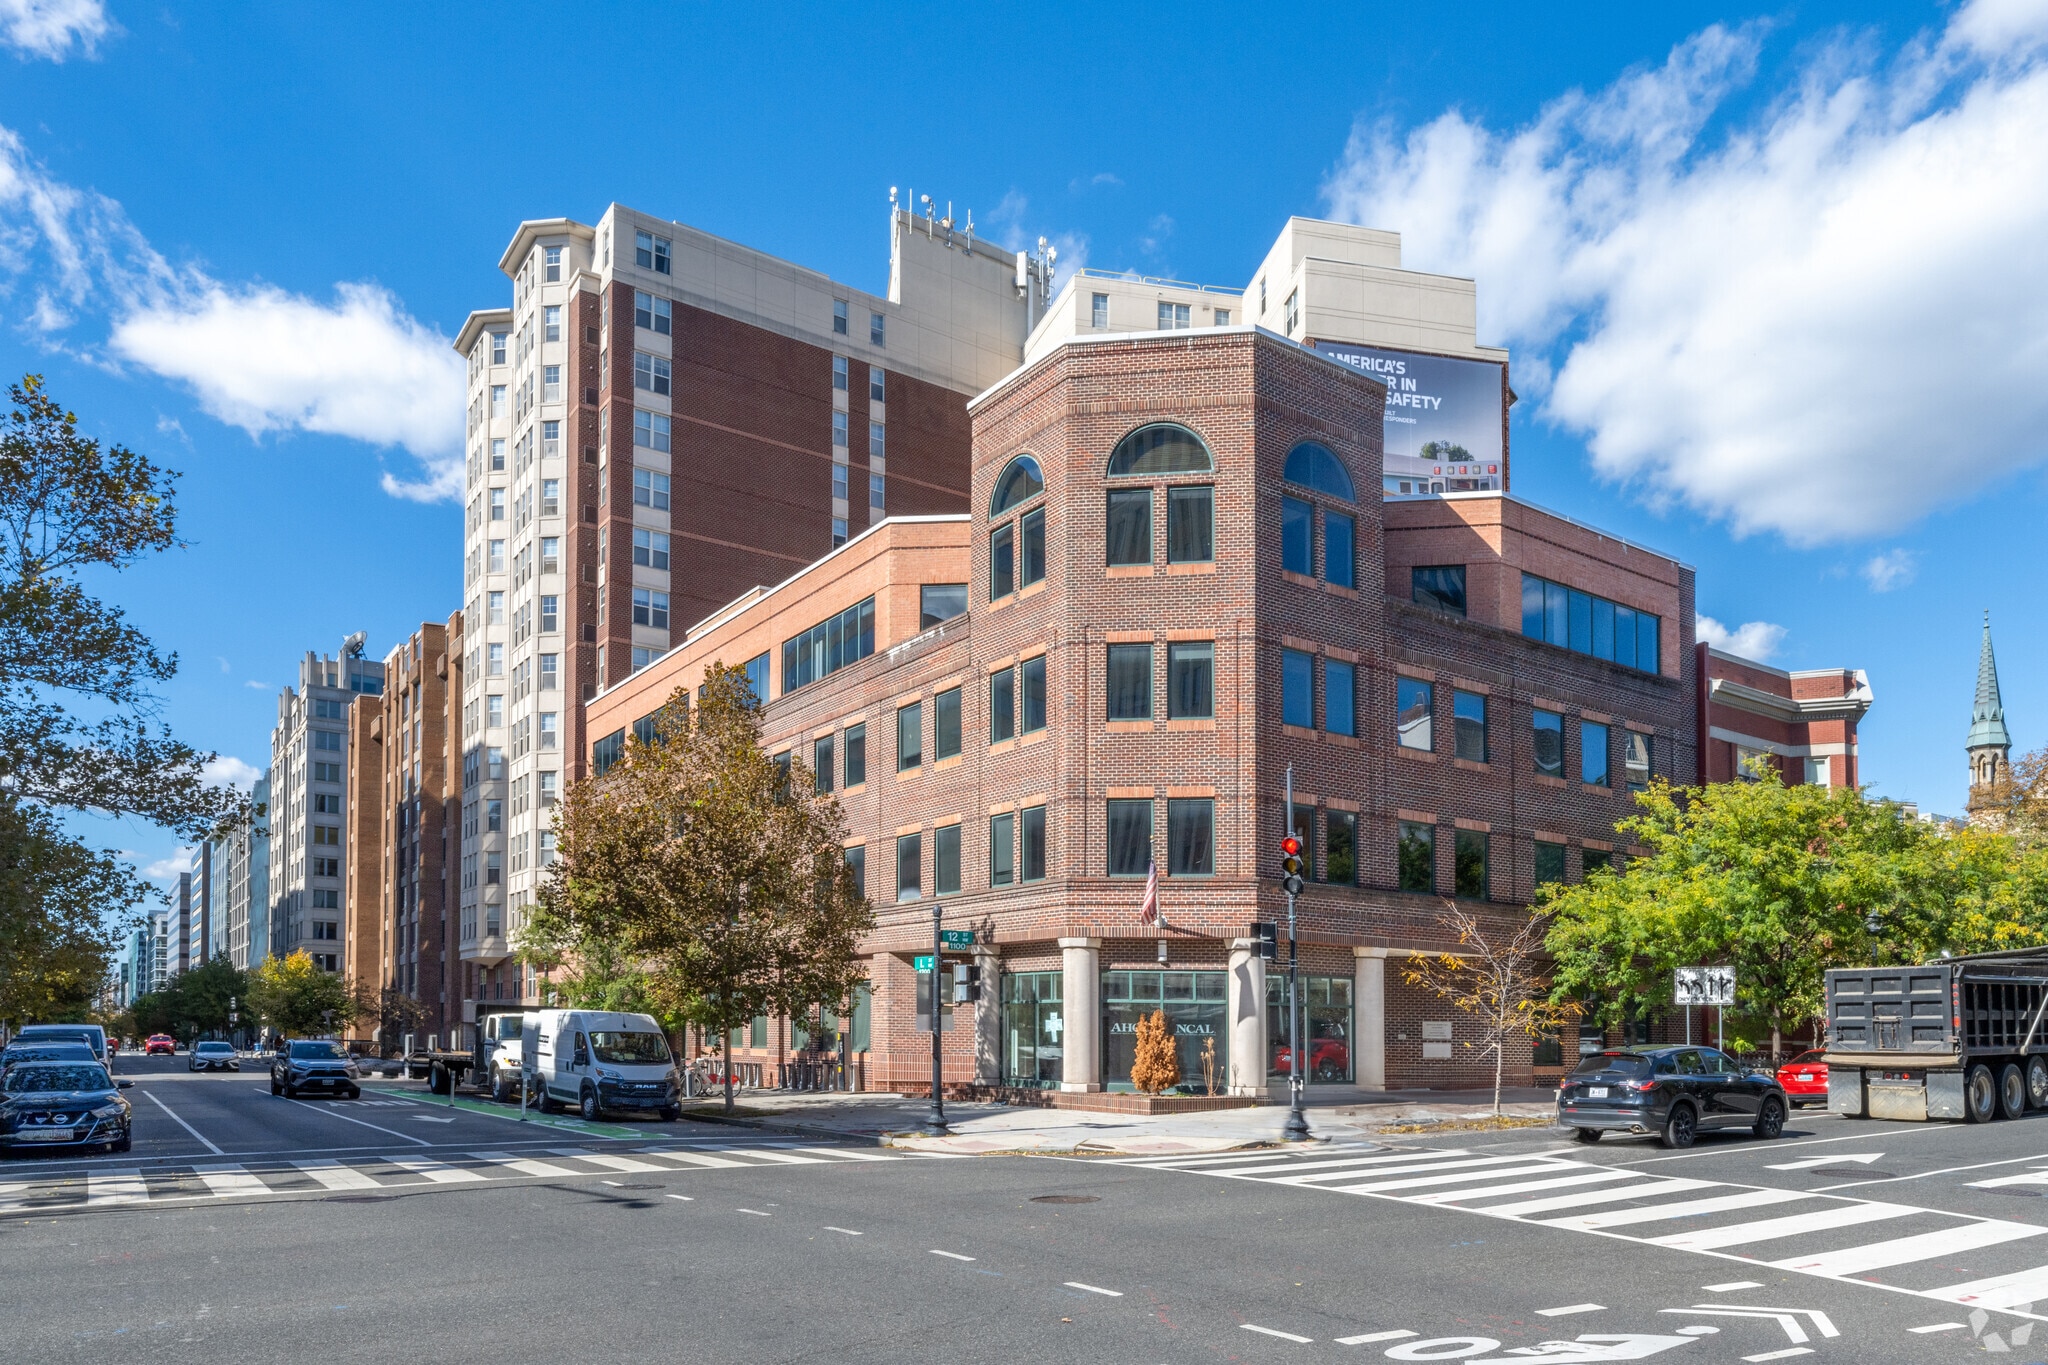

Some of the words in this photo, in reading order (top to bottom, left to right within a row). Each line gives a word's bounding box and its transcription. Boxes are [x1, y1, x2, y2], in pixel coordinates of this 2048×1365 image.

[1401, 377, 1416, 392] IN
[1385, 391, 1442, 410] SAFETY
[1384, 415, 1417, 424] ESPONDERS
[947, 931, 958, 941] 12
[920, 958, 925, 968] L
[1175, 1024, 1214, 1034] NCAL
